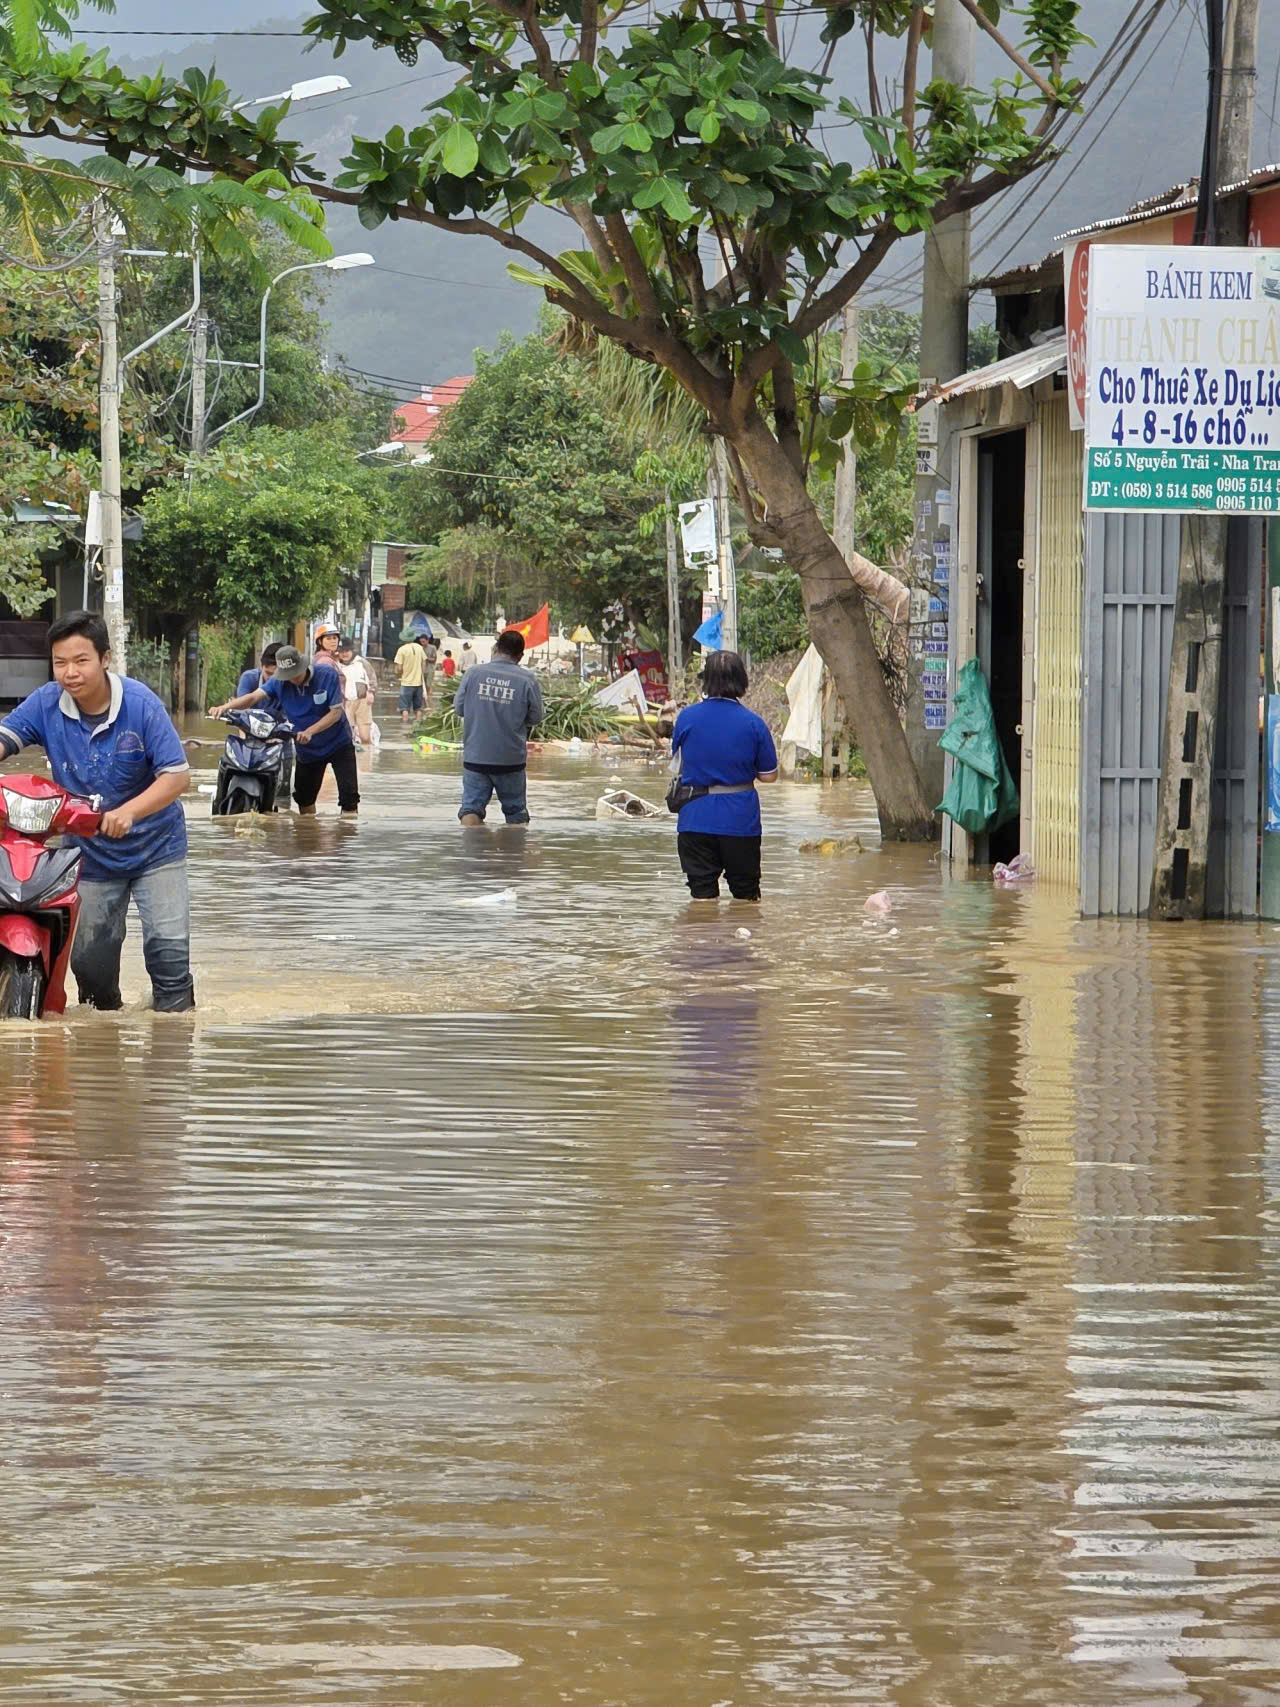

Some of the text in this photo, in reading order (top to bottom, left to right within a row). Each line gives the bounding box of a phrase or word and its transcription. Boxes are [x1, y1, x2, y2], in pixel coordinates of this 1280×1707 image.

[1145, 262, 1253, 300] BÁNH KEM
[1095, 315, 1201, 364] THANH
[1098, 366, 1136, 404] Cho
[1140, 366, 1189, 405] Thuê
[1193, 368, 1219, 406] Xe
[1093, 450, 1113, 468] Số
[1114, 453, 1123, 468] 5
[1125, 450, 1178, 472] Nguyễn
[1180, 453, 1210, 470] Trãi
[1221, 454, 1250, 470] Nha
[1090, 481, 1111, 497] ĐT
[1121, 483, 1152, 499] (058)
[1155, 483, 1163, 498] 3
[1166, 484, 1188, 499] 514
[1191, 485, 1213, 499] 586
[1216, 477, 1246, 493] 0905
[1250, 477, 1272, 493] 514
[1216, 495, 1246, 511] 0905
[1250, 495, 1272, 511] 110
[477, 682, 516, 701] HTH
